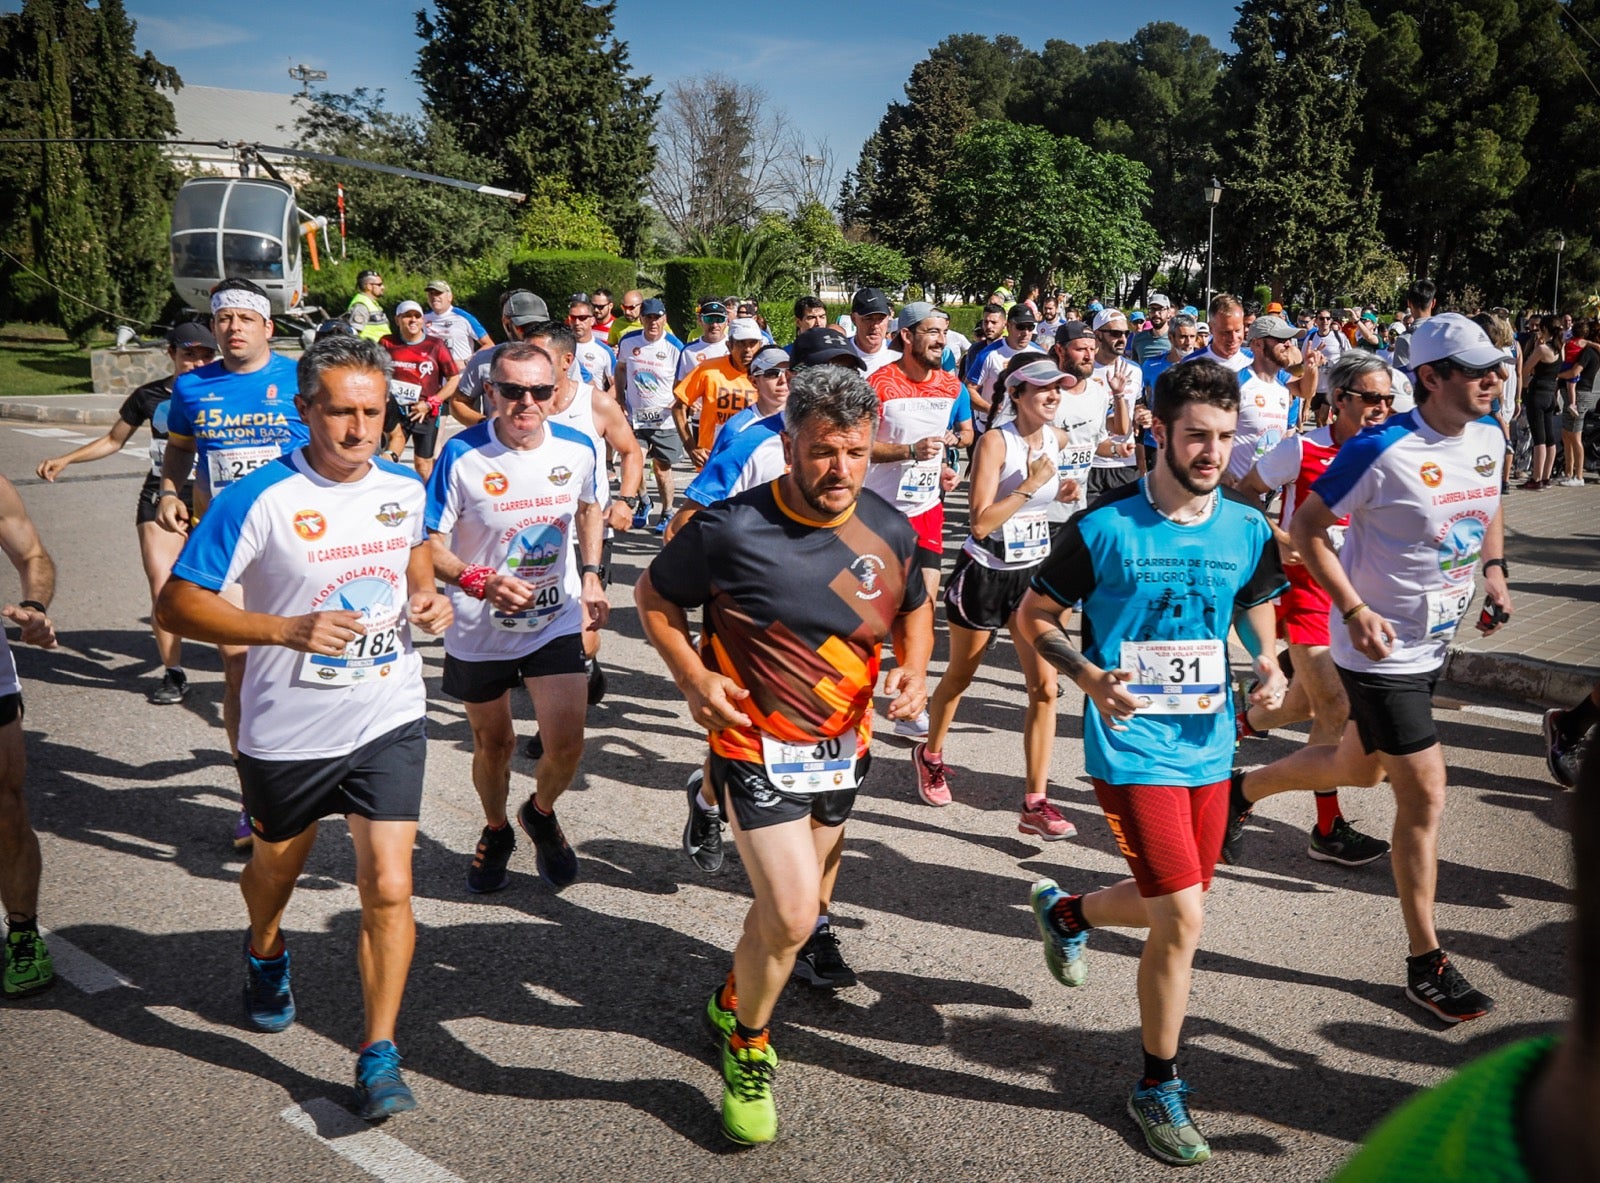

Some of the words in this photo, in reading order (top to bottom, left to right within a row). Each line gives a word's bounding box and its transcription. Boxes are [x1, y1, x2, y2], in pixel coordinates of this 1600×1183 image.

[398, 388, 416, 397] 346
[260, 427, 291, 437] BAZA
[1071, 451, 1091, 464] 268
[500, 500, 533, 511] CARRERA
[535, 497, 553, 507] BASE
[1027, 521, 1047, 539] 173
[317, 545, 359, 562] CARRERA
[361, 541, 383, 555] BASE
[1136, 558, 1184, 567] CARRERA
[1187, 559, 1201, 567] DE
[1204, 560, 1238, 571] FONDO
[536, 586, 559, 607] 40
[355, 629, 395, 657] 182
[1169, 657, 1200, 683] 31
